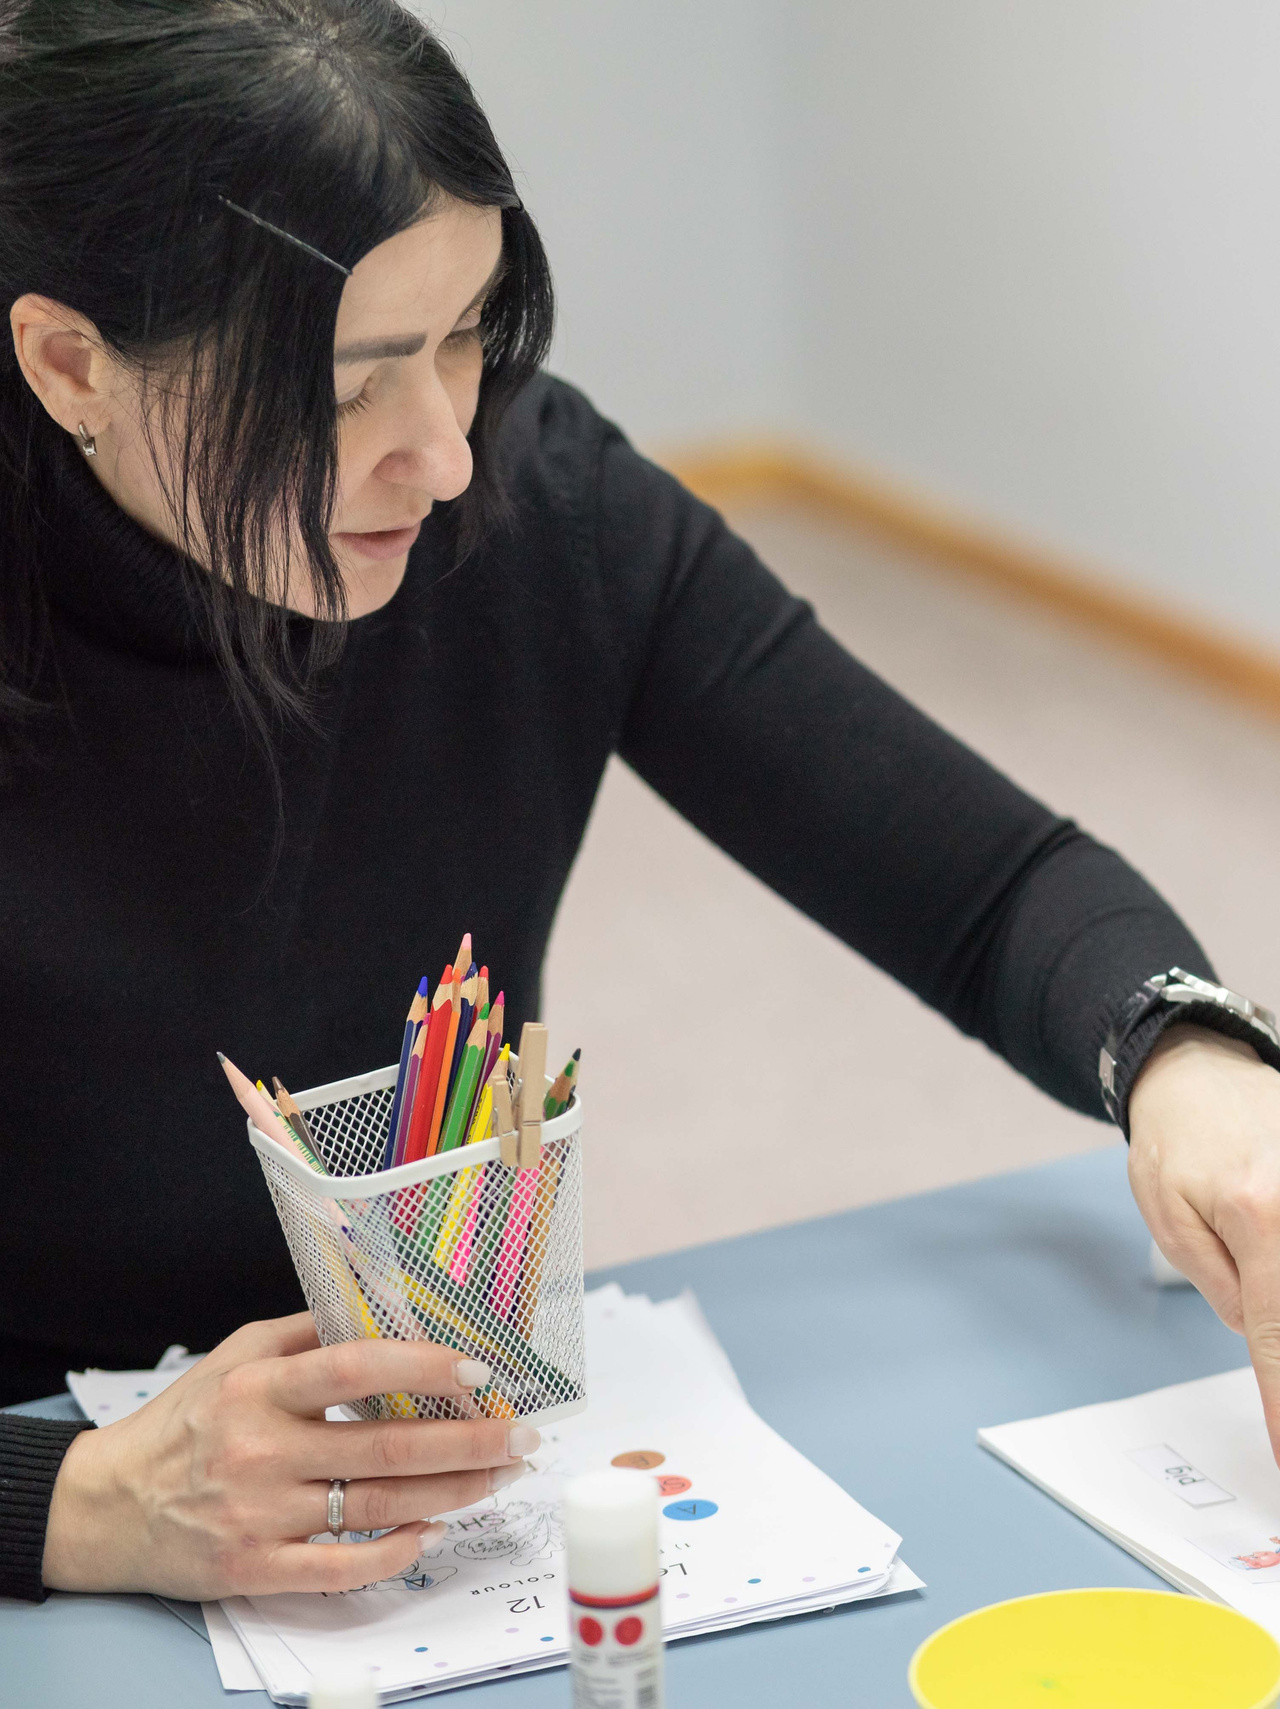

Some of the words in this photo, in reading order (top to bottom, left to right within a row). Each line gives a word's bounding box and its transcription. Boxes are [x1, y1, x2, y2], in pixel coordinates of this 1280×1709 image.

[1163, 1464, 1199, 1489] pig
[468, 1572, 556, 1597] COLOUR
[506, 1595, 547, 1615] 12
